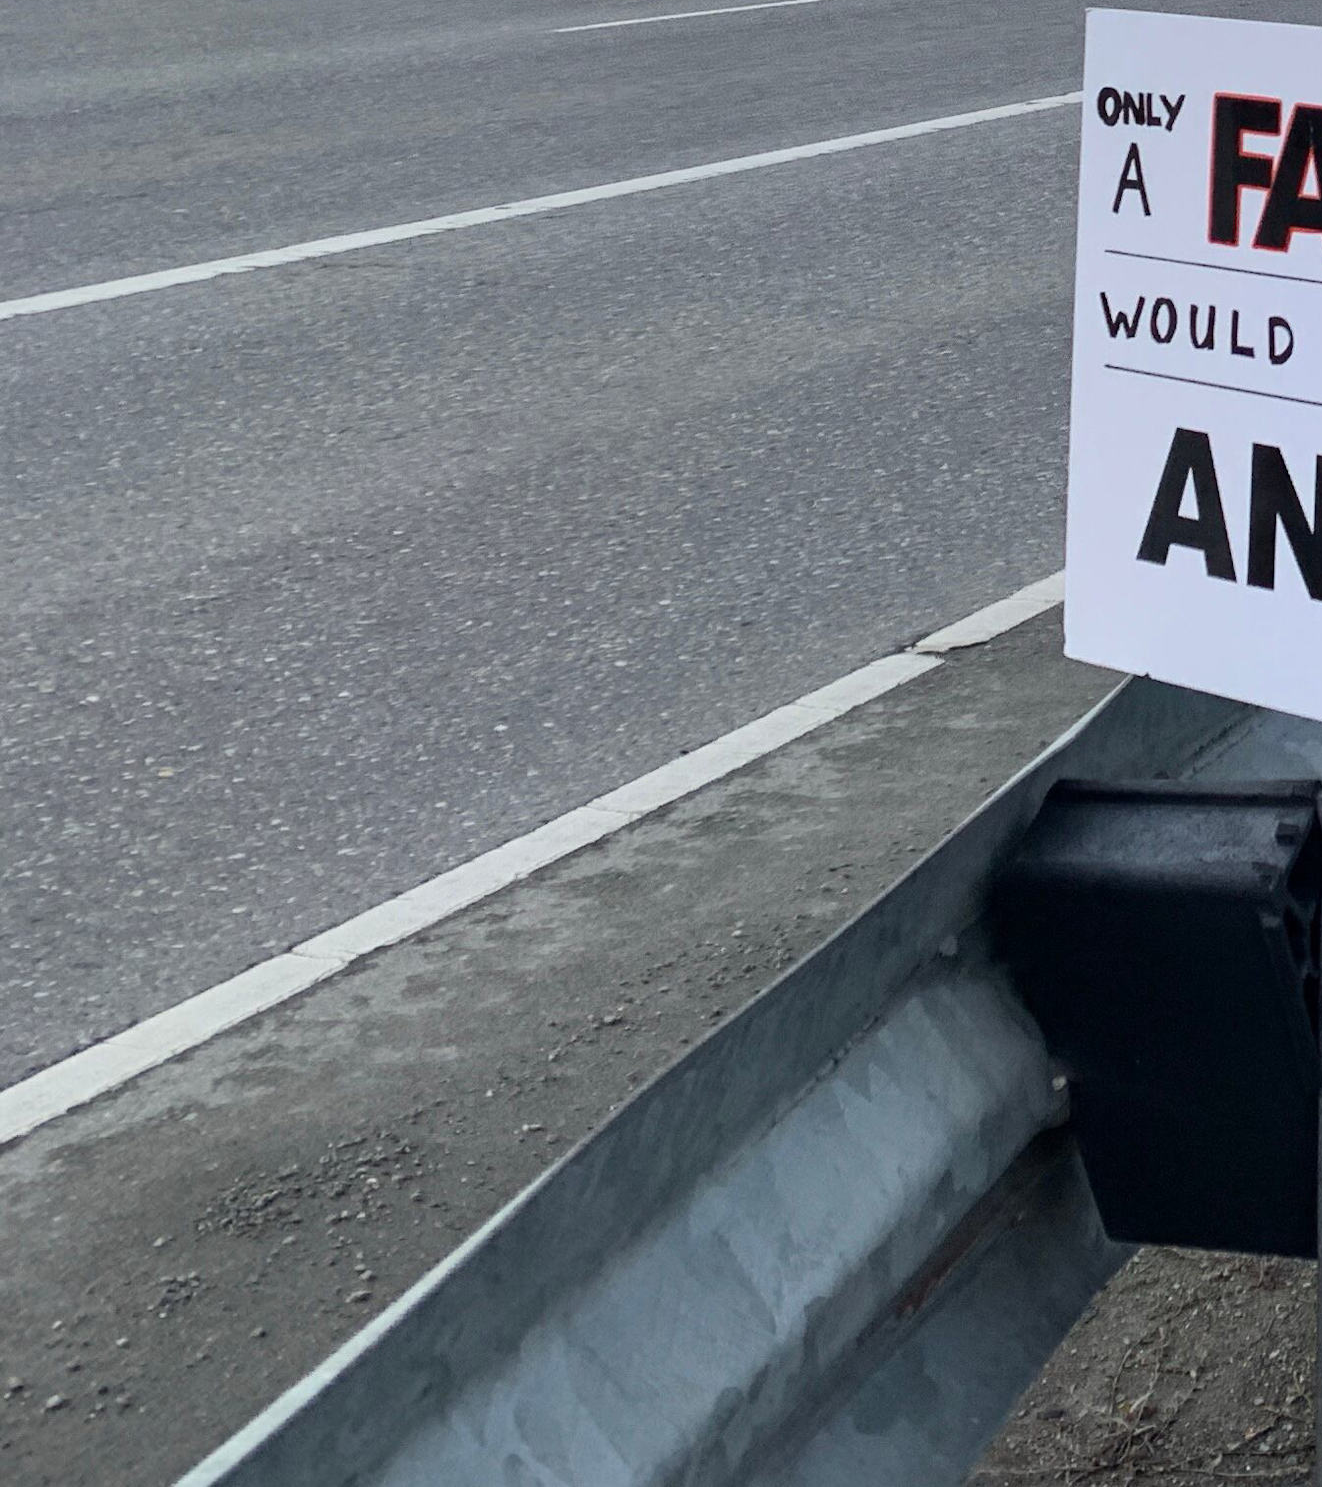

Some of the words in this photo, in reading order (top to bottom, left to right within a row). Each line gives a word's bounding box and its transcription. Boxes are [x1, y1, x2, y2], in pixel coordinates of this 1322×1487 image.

[1097, 86, 1186, 132] ONLY
[1112, 142, 1151, 217] A
[1100, 291, 1295, 366] WOULD
